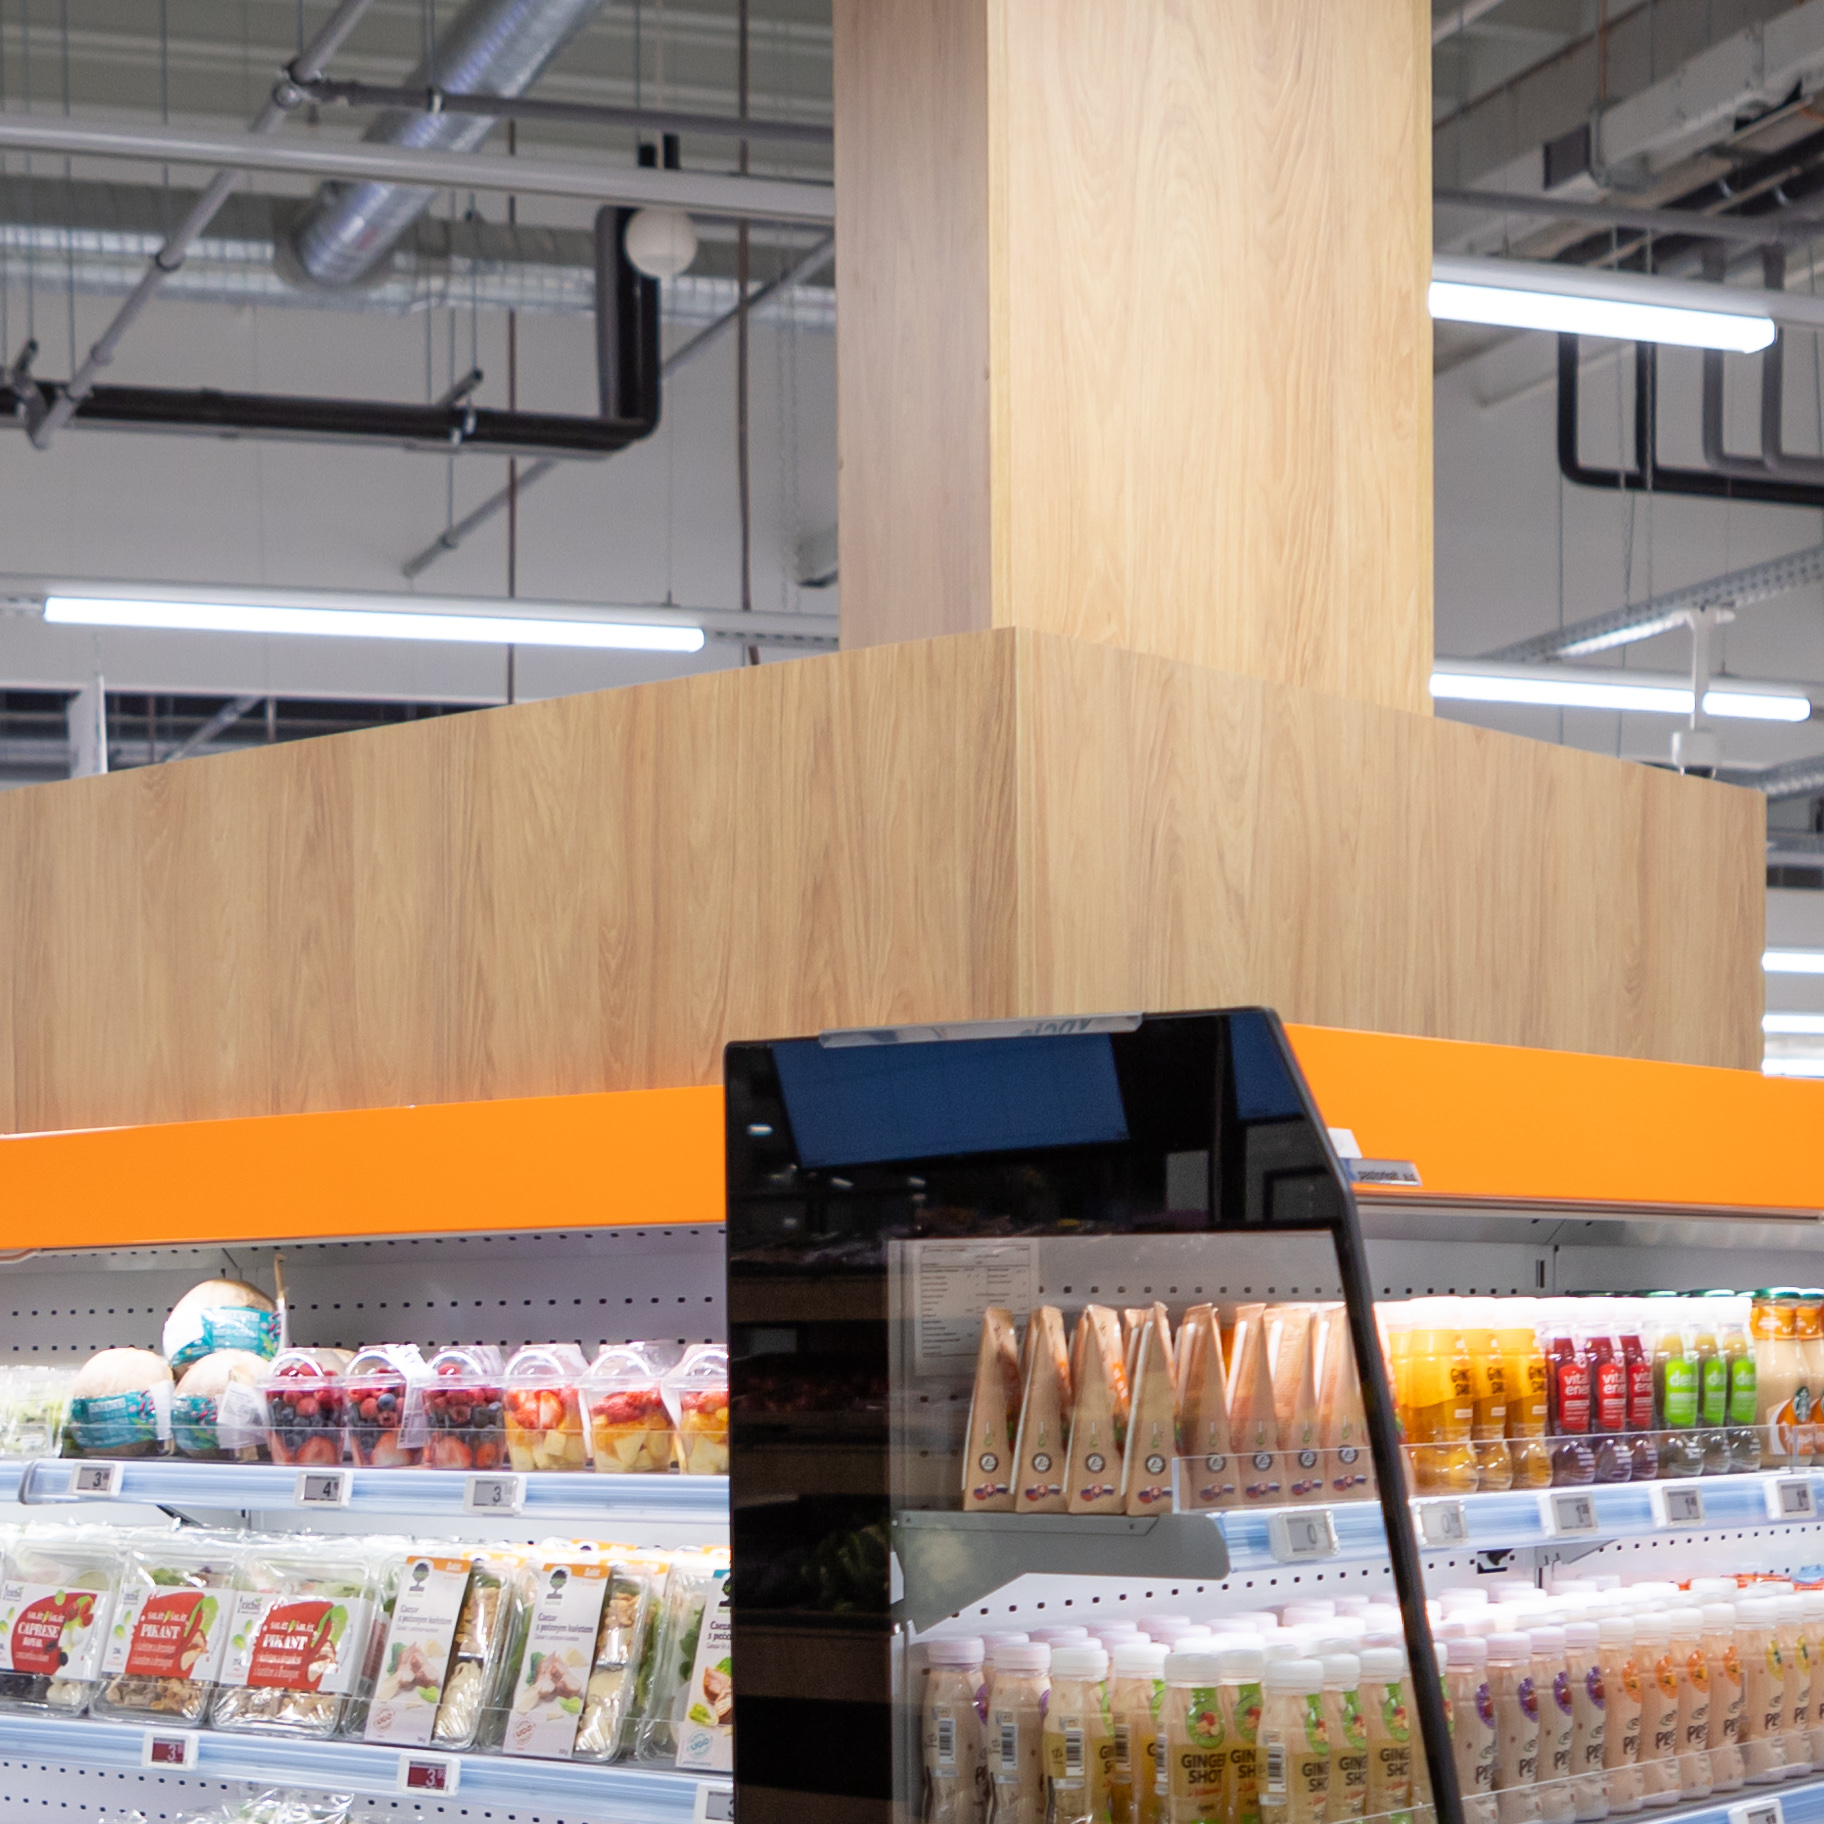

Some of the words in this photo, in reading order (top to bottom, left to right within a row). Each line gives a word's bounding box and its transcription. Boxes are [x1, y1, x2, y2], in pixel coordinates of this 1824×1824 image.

[17, 1621, 62, 1639] CAPRESE
[139, 1623, 182, 1641] PIKANT
[262, 1633, 309, 1651] PIKANT
